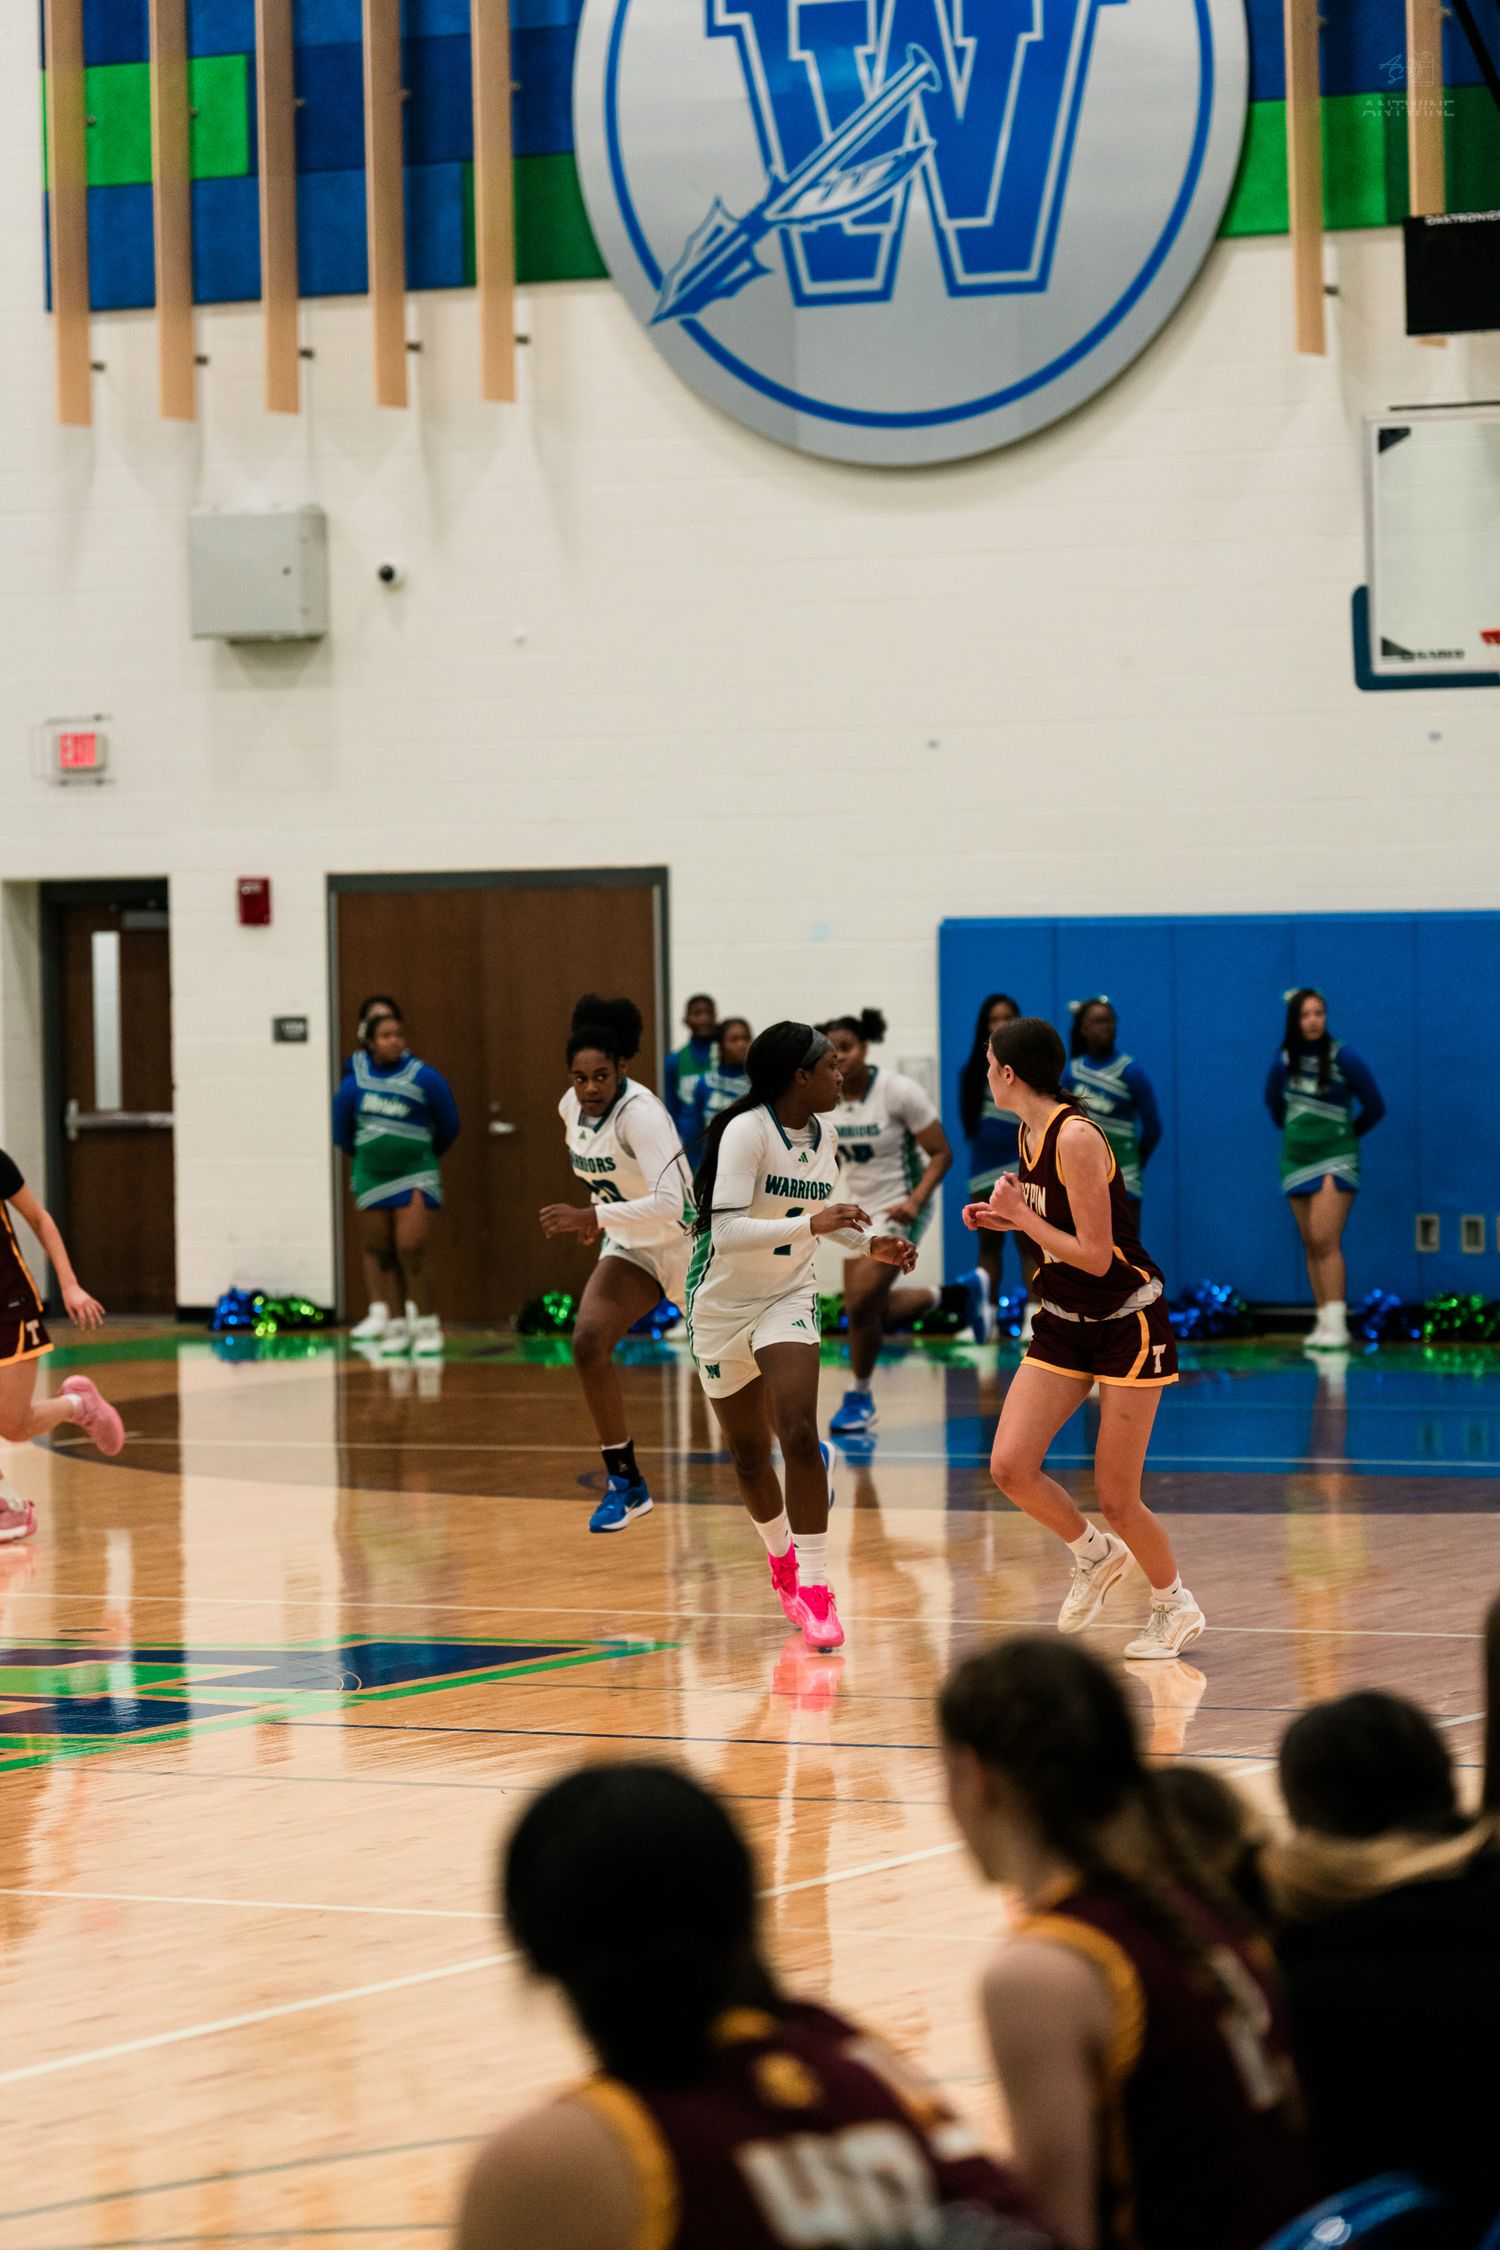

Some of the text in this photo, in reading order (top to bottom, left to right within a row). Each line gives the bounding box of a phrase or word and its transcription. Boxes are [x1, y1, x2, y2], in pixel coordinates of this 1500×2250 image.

[765, 1174, 832, 1201] WARRIORS
[25, 1319, 40, 1346] T
[1152, 1343, 1167, 1374] T
